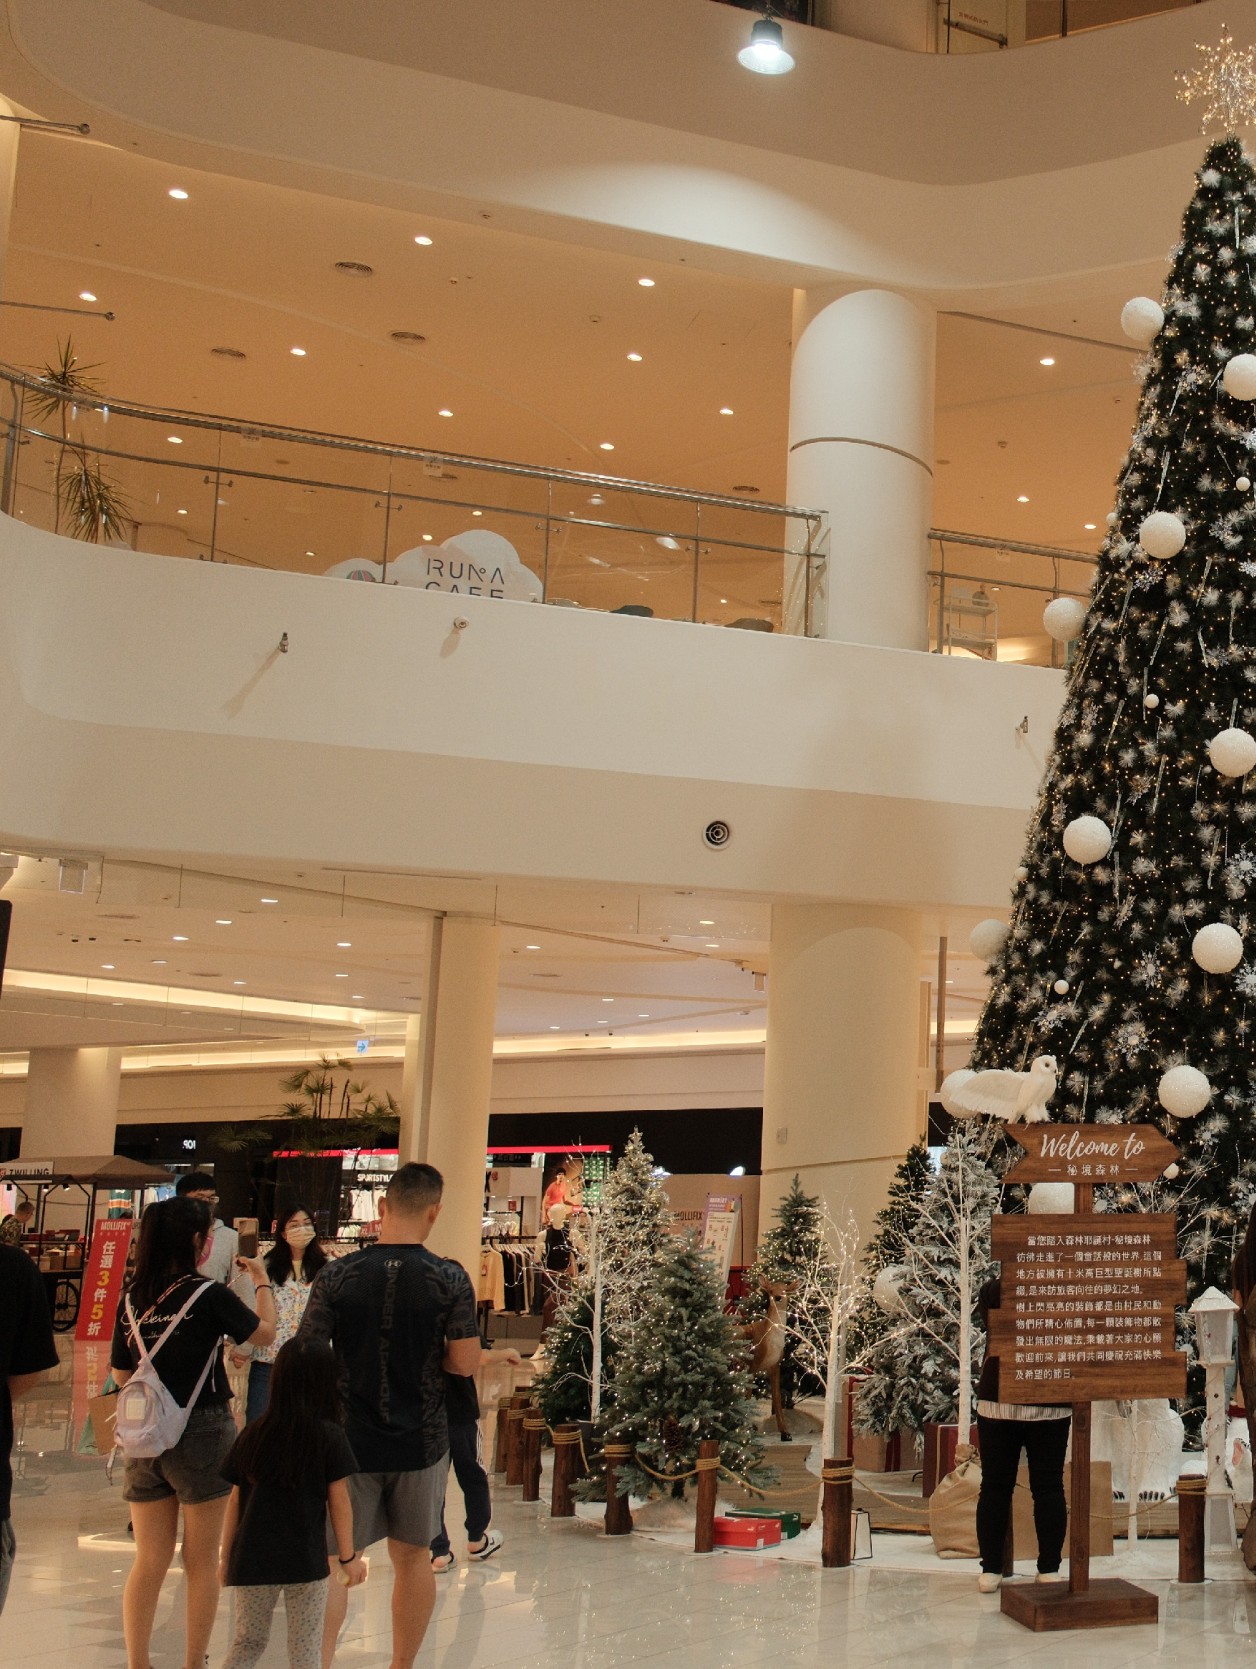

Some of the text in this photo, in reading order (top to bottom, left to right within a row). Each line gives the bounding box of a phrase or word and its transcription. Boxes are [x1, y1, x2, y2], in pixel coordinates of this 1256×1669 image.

[1040, 1130, 1146, 1160] Welcome to
[1067, 1164, 1120, 1176] 秘境森林
[357, 1173, 394, 1183] SPORTSTYL
